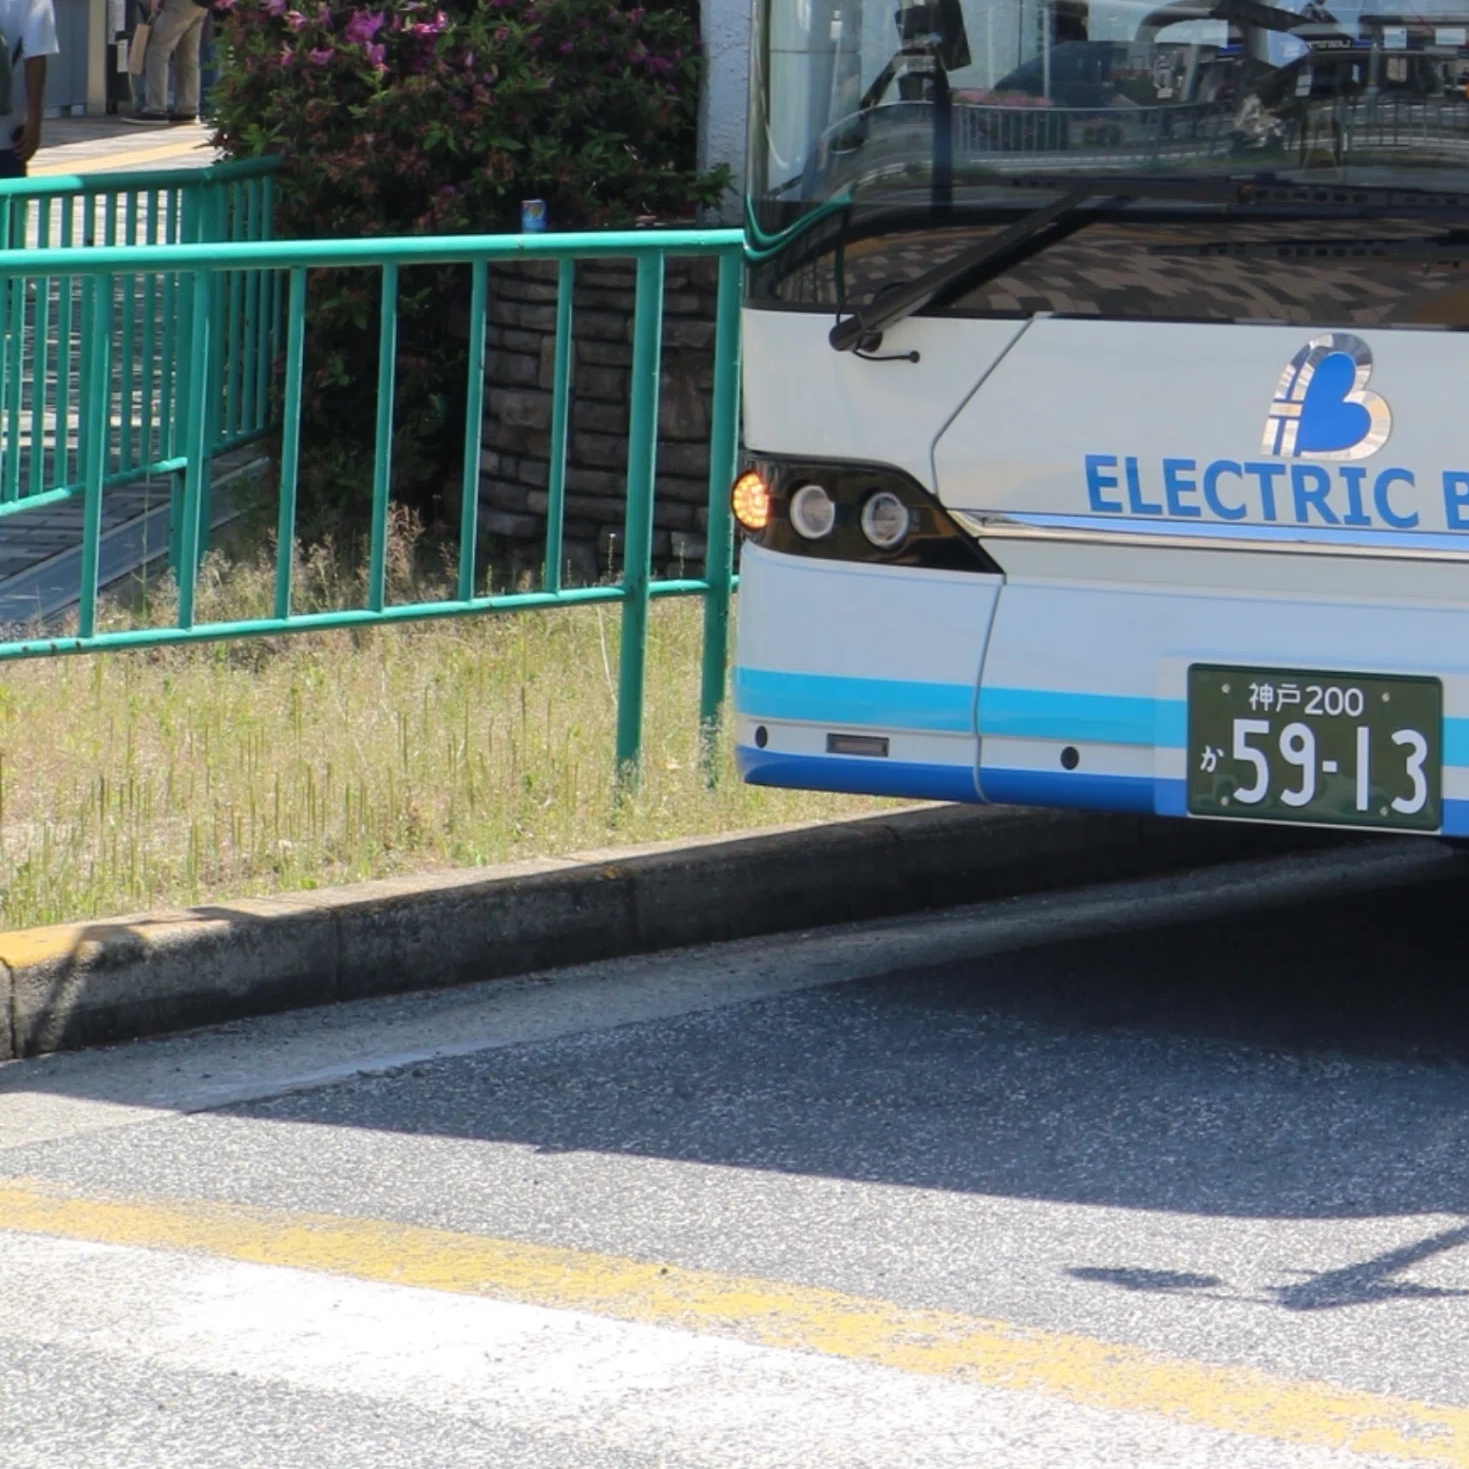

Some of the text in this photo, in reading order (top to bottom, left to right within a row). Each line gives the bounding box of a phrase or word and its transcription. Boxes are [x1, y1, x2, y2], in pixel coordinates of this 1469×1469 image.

[1084, 453, 1421, 530] ELECTRIC
[1200, 718, 1428, 815] か 59-13
